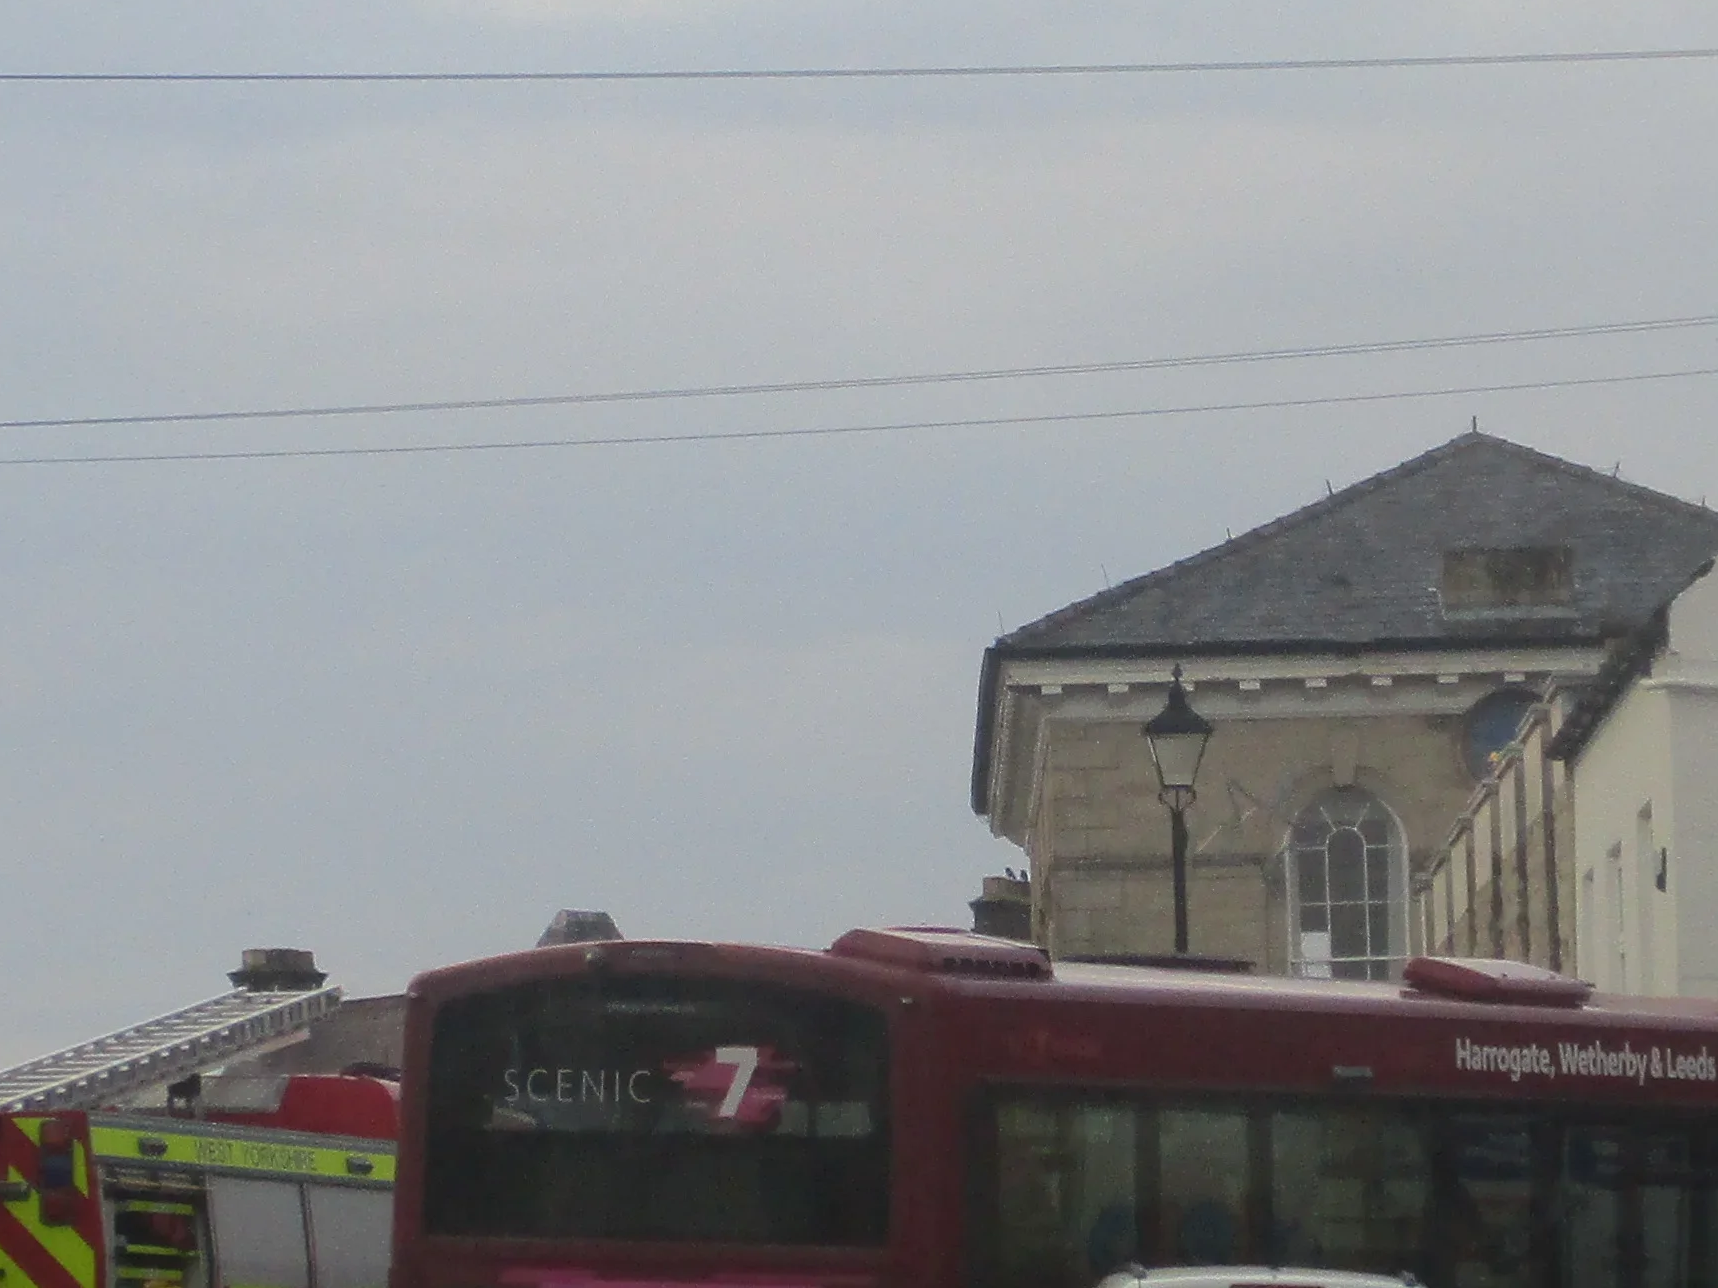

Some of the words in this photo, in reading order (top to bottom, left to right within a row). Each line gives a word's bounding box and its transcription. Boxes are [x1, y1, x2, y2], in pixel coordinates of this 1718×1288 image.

[715, 1045, 759, 1118] 7
[1455, 1036, 1556, 1082] Harrogate,
[1558, 1039, 1647, 1087] Wetherby
[1650, 1046, 1664, 1079] &
[1666, 1045, 1718, 1082] Leeds
[503, 1067, 652, 1105] SCENIC
[194, 1139, 234, 1165] WEST
[243, 1143, 318, 1173] YORKSHIRE
